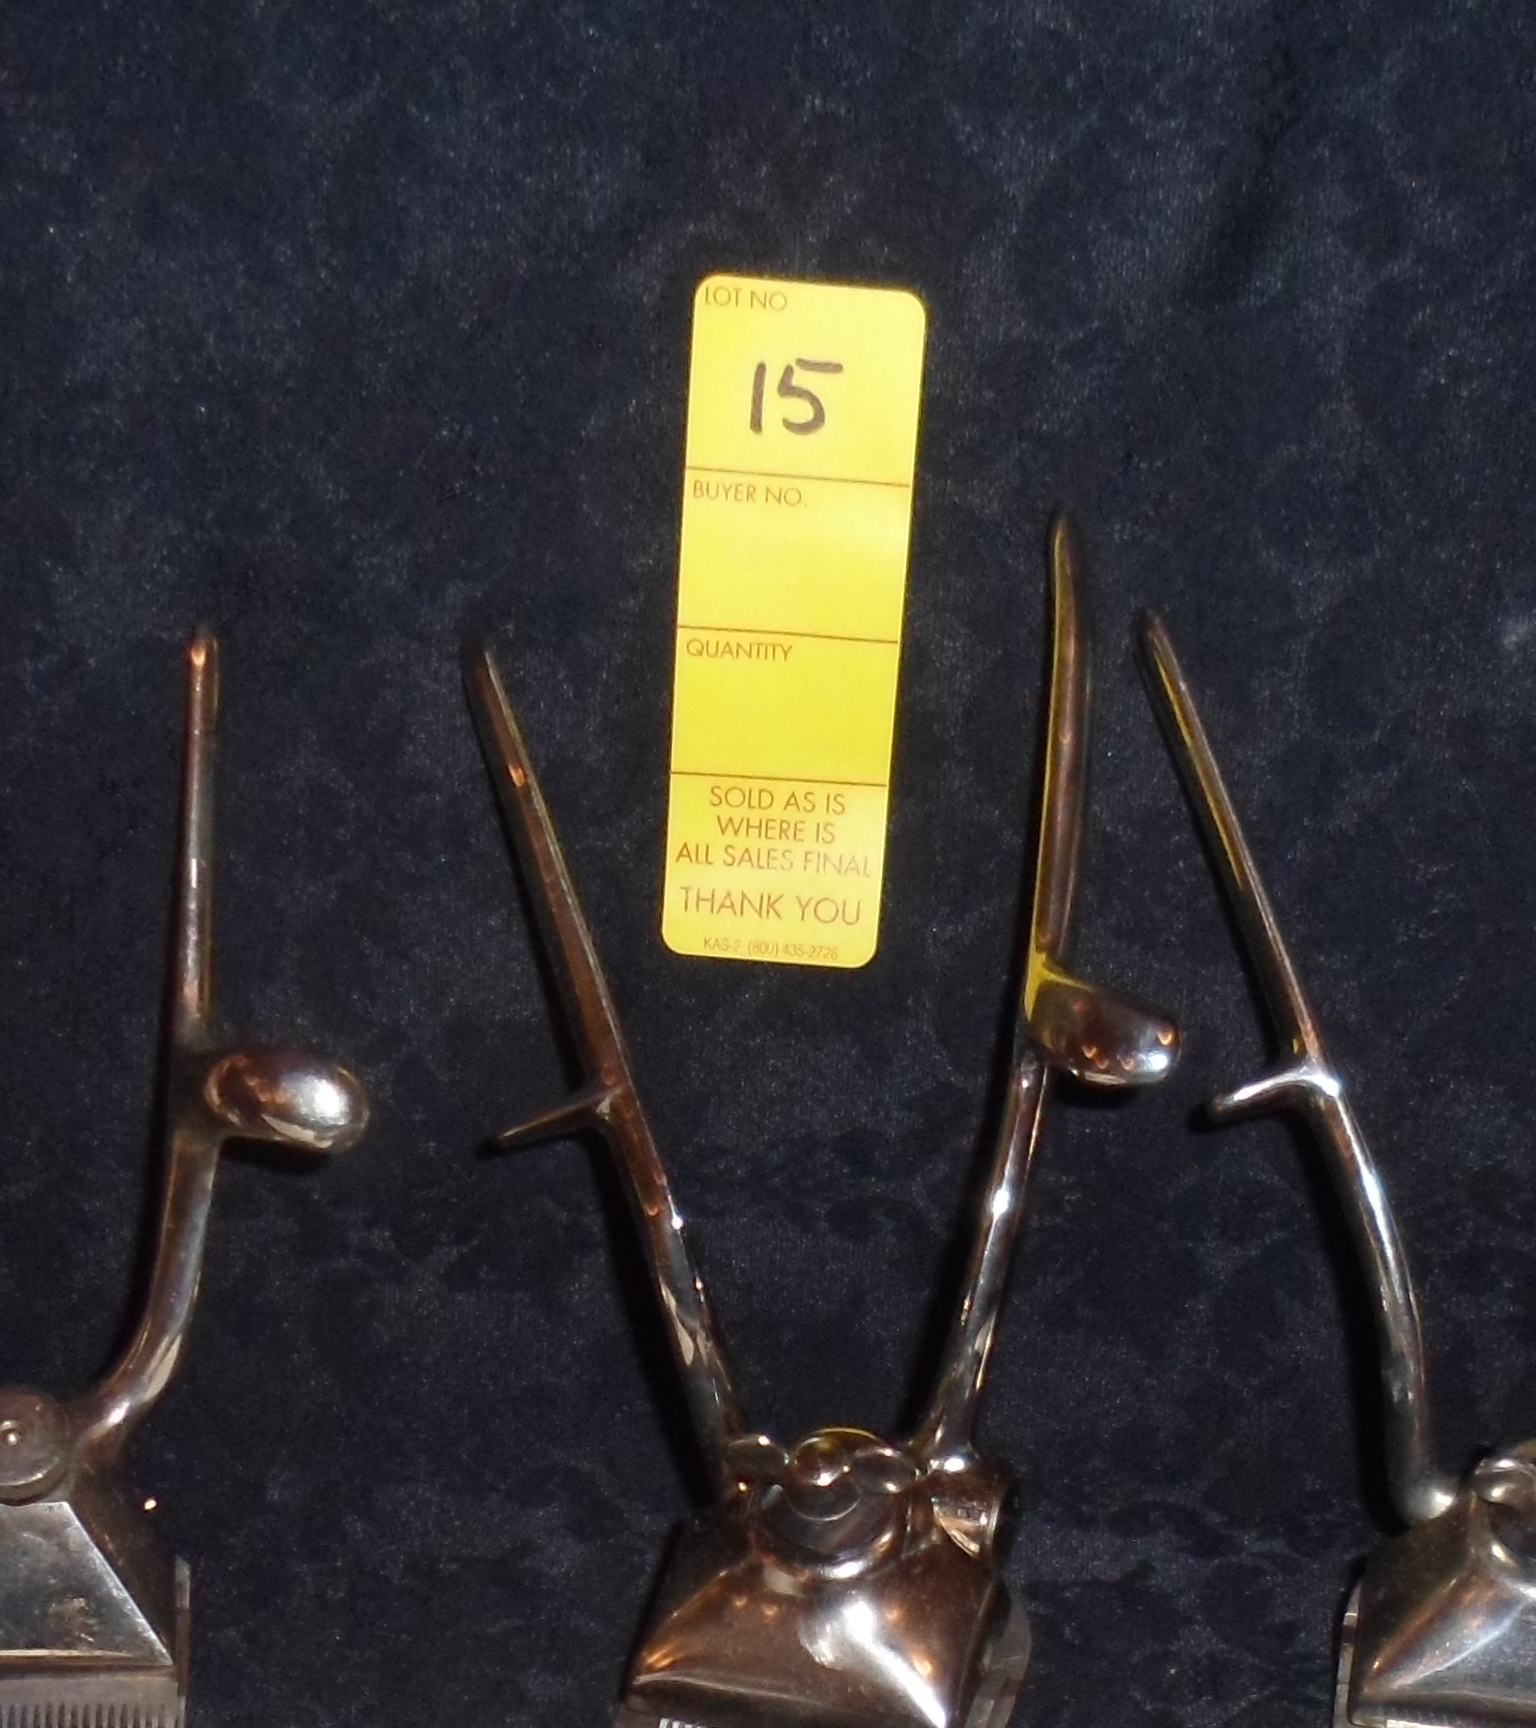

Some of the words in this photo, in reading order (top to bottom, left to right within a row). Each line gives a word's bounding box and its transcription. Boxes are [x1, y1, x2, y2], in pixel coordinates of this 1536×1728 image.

[705, 286, 742, 307] LOT
[749, 358, 844, 436] 15
[693, 480, 756, 503] BUYER
[686, 639, 792, 661] QUANTITY
[710, 785, 774, 809] SOLD
[784, 791, 816, 813] AS
[826, 793, 846, 815] IS
[717, 815, 806, 842] WHERE
[816, 823, 836, 844] IS
[675, 842, 713, 865] ALL
[723, 845, 793, 871] SALES
[803, 851, 871, 877] FINAL
[680, 887, 784, 920] THANK
[796, 896, 861, 925] YOU
